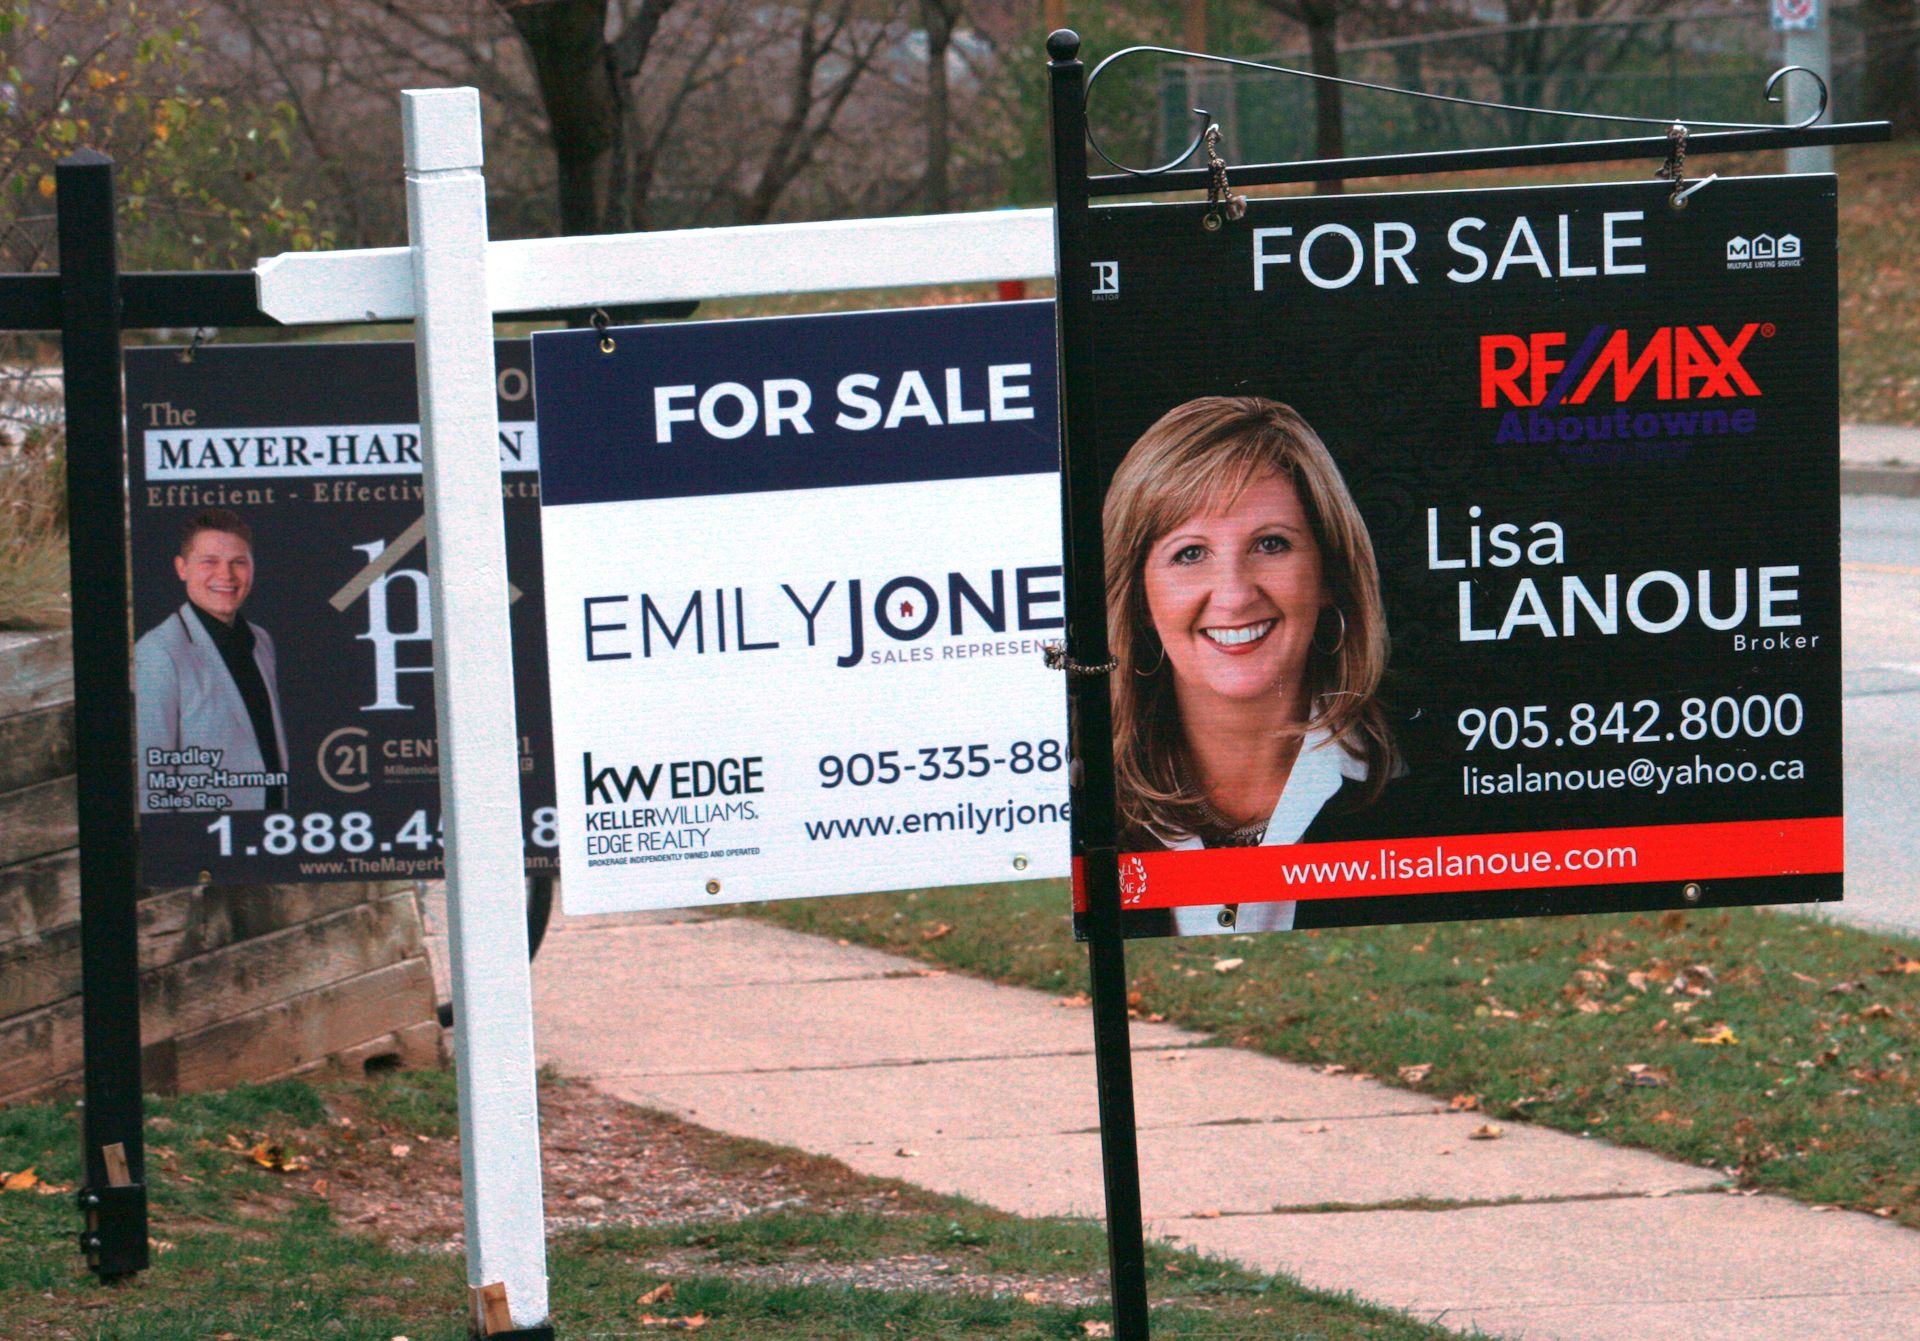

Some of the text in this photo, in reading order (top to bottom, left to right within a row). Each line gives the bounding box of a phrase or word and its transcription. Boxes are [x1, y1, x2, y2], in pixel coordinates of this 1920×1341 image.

[1252, 210, 1647, 291] FOR SALE
[1726, 261, 1753, 270] MULTIPLE
[1754, 260, 1776, 269] LISTING
[1728, 237, 1799, 258] MLS
[143, 402, 197, 426] The
[653, 362, 1035, 444] FOR SALE
[1495, 406, 1757, 444] Aboutowne
[157, 430, 524, 470] MAYER-HARN
[147, 484, 276, 507] Efficient
[313, 480, 425, 502] Effectiv
[1427, 505, 1564, 570] Lisa
[583, 564, 1064, 671] EMILYJONE
[1457, 564, 1802, 642] LANOUE
[870, 638, 1063, 664] SALES REPRESENT
[1734, 631, 1819, 652] Broker
[1457, 693, 1804, 752] 905.842.8000
[149, 747, 222, 768] Bradley
[818, 738, 1070, 789] 905-335-88
[1462, 754, 1805, 797] lisalanoue@yahoo.ca
[149, 771, 289, 792] Mayer-Harman
[583, 751, 765, 806] kw EDGE
[149, 793, 232, 809] Sales Rep.
[804, 799, 1071, 841] www.emilyrjone
[587, 828, 711, 856] EDGE REALTY
[588, 848, 760, 867] BROKERAGE INDEPENDENTLY OWNED AND OPERATED
[1281, 842, 1638, 886] www.lisalanoue.com
